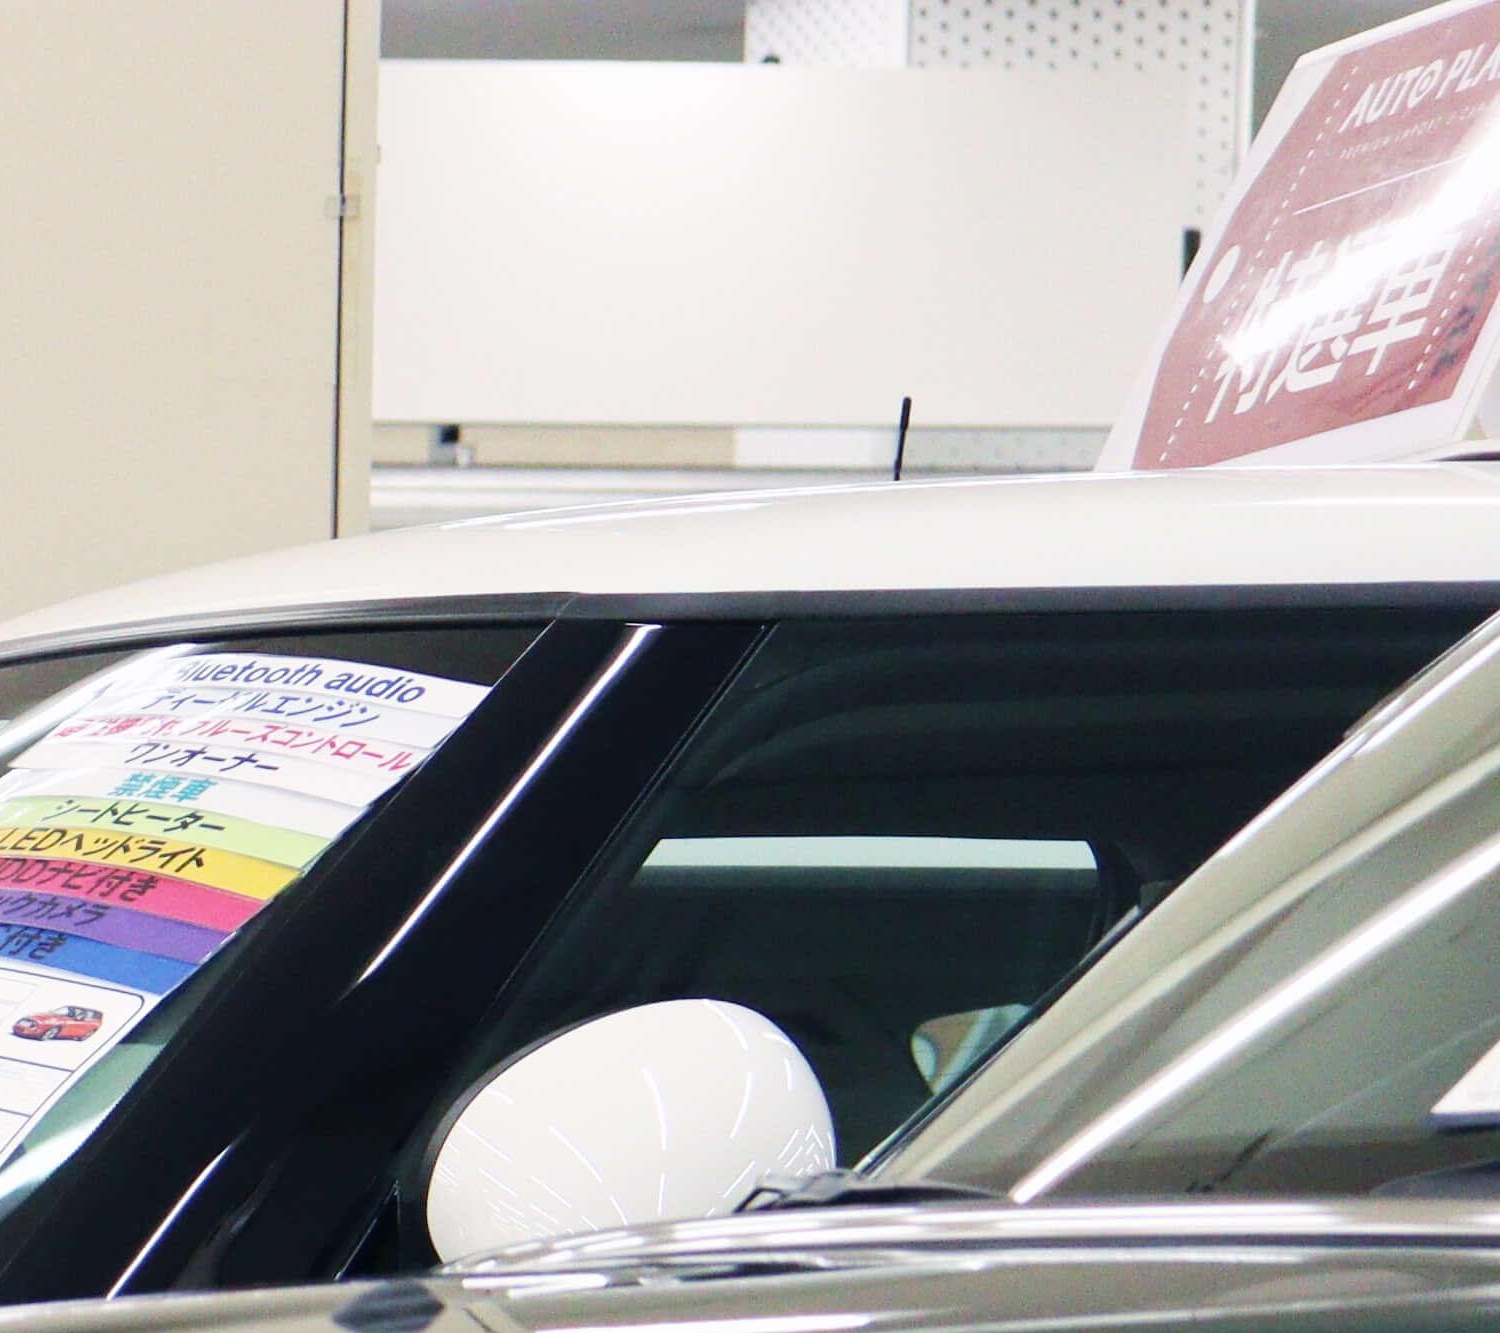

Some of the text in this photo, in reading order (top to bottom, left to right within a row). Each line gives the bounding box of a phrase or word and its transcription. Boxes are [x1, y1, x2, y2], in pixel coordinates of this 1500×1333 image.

[325, 669, 425, 704] audio
[130, 740, 281, 773] ワンオーナー
[109, 773, 219, 802] 禁煙車
[42, 799, 227, 833] シートヒーター
